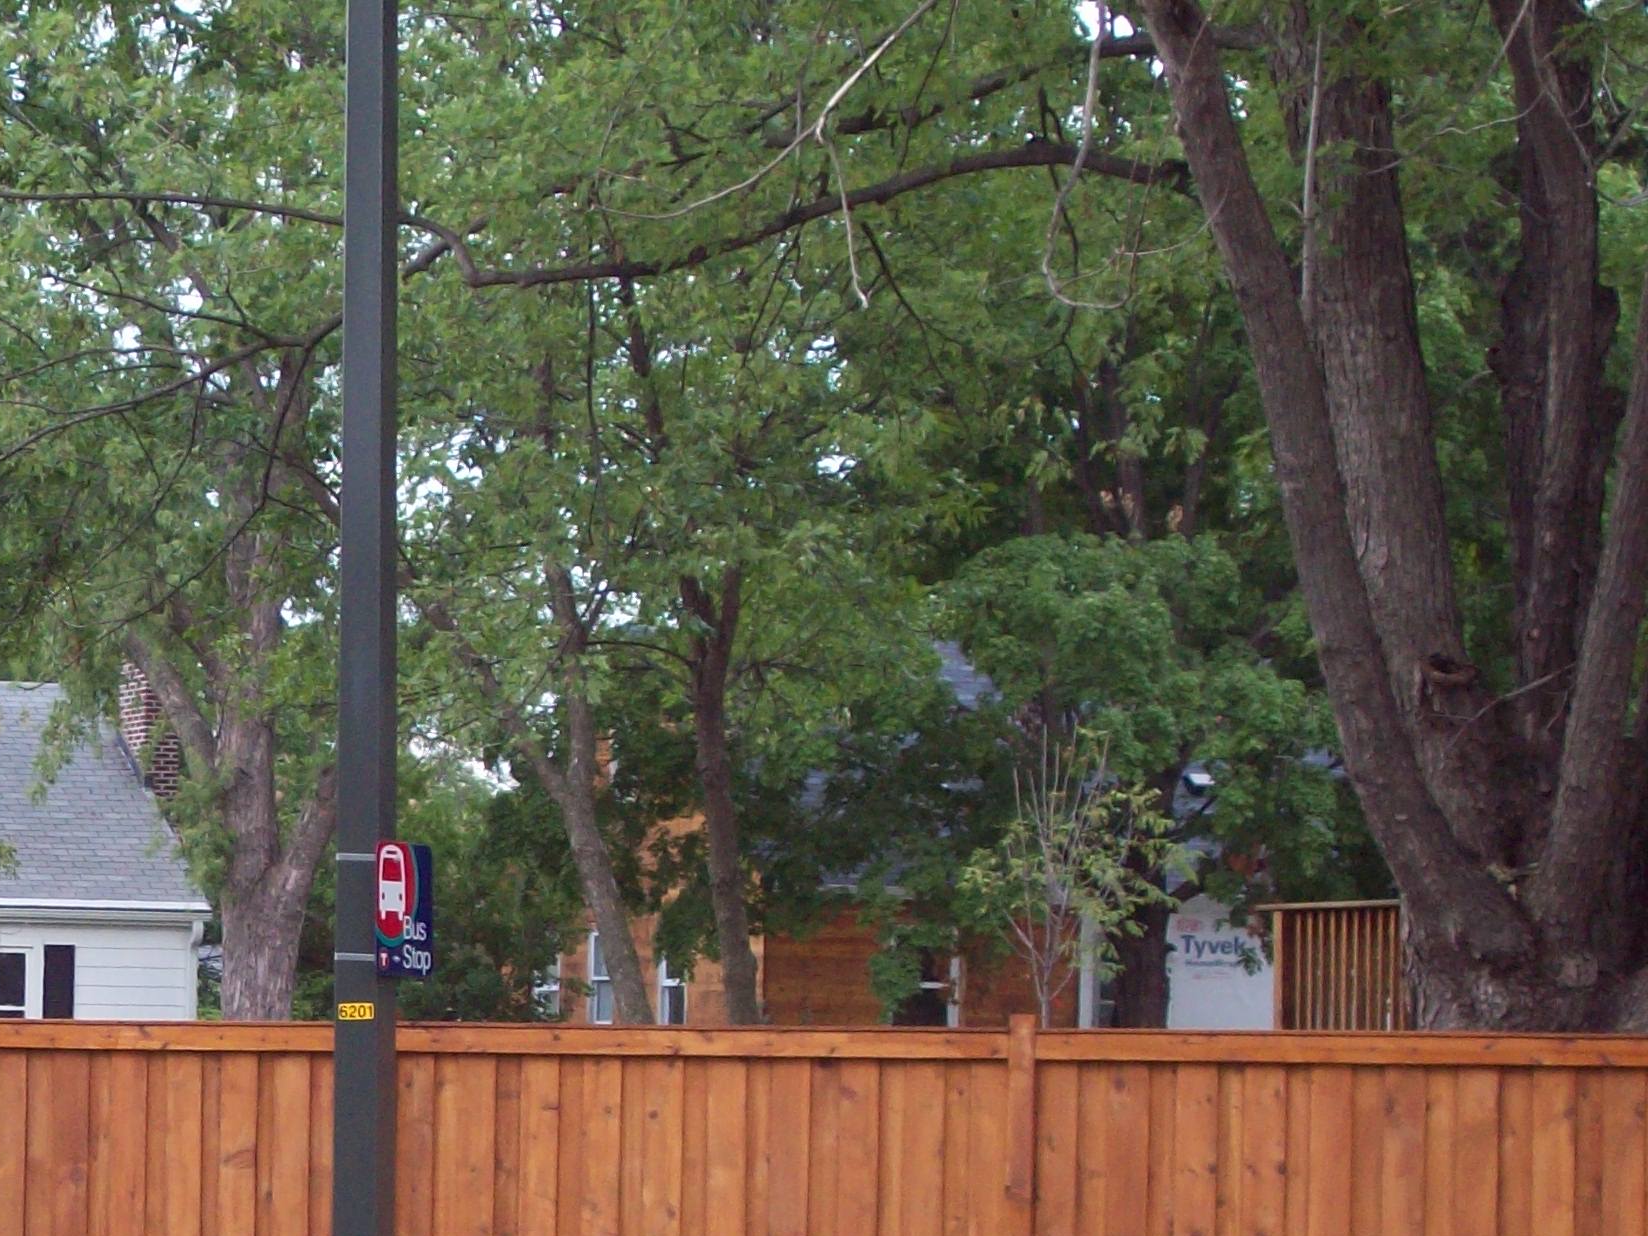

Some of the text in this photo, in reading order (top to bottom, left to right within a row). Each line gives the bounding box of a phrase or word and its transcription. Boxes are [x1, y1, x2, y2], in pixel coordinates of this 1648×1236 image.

[404, 915, 427, 940] Bus
[1180, 934, 1246, 959] Tyvek
[402, 944, 432, 976] Stop
[340, 1004, 373, 1018] 6201
